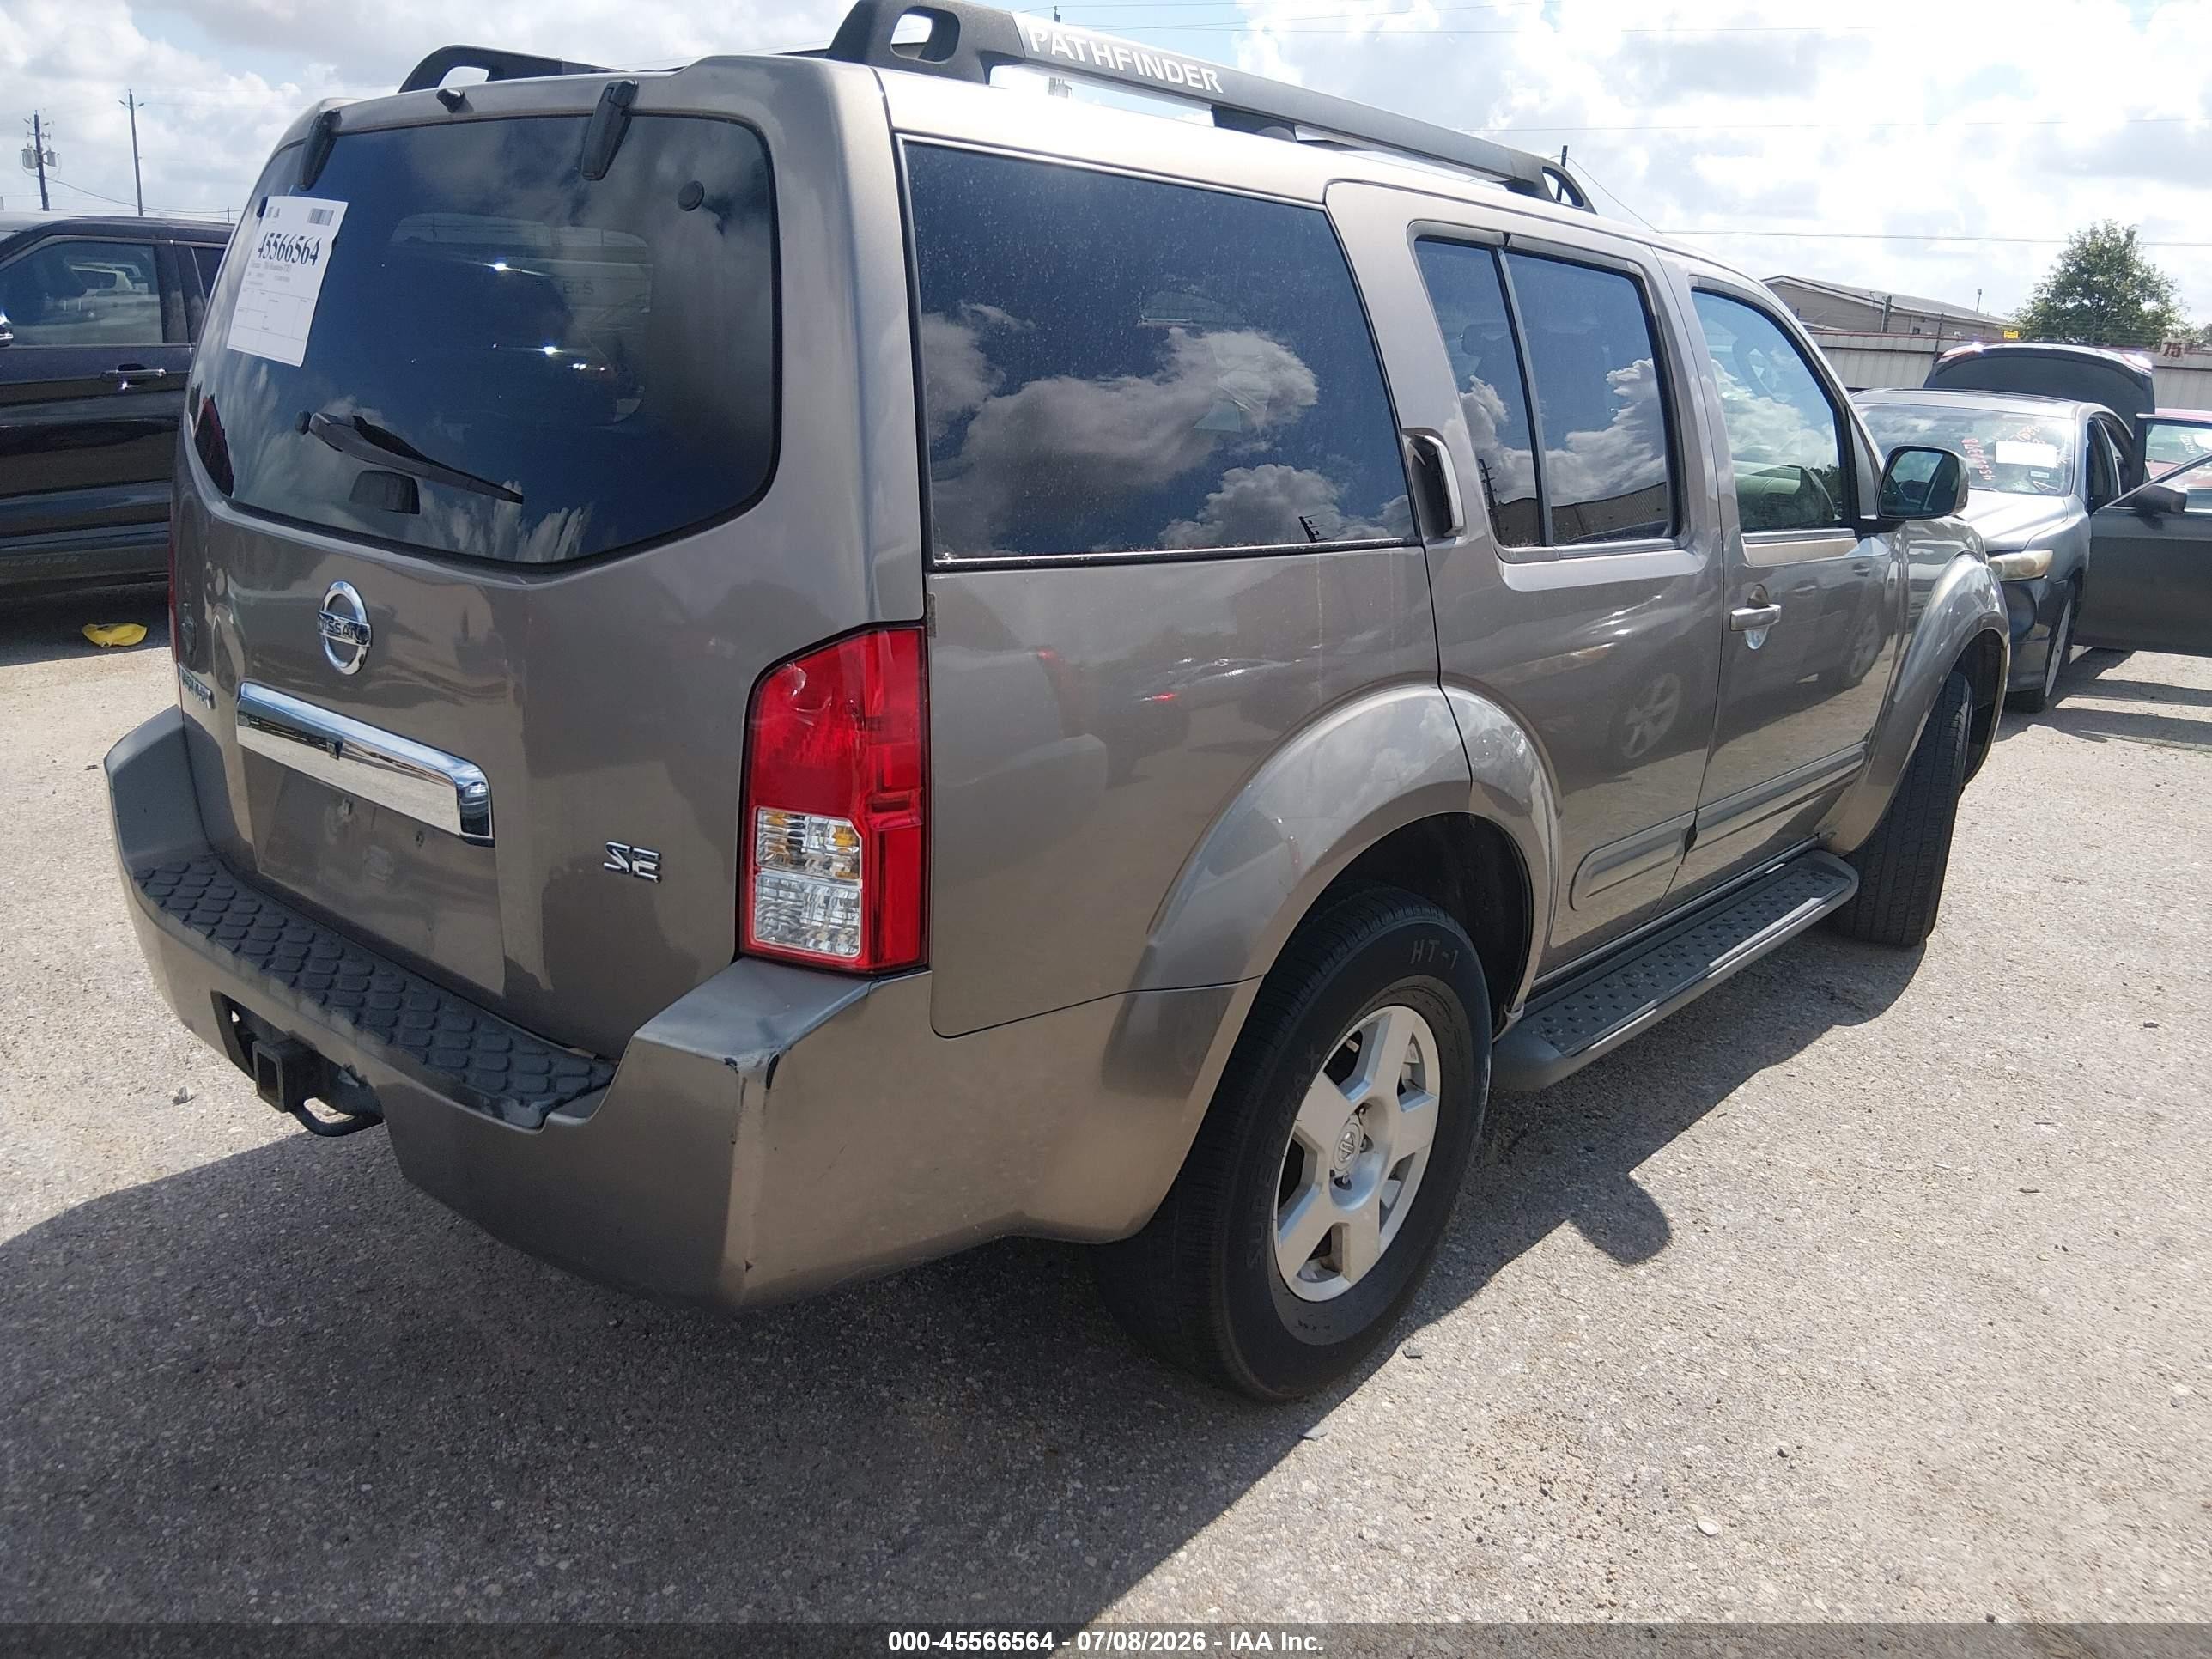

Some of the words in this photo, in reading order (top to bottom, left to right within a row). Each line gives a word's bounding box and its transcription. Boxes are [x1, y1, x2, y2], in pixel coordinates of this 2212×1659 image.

[1027, 27, 1224, 94] PATHFINDER
[258, 232, 322, 266] 45566564
[318, 612, 361, 641] NISSAN
[602, 841, 661, 884] SE
[1409, 939, 1459, 970] HT-1
